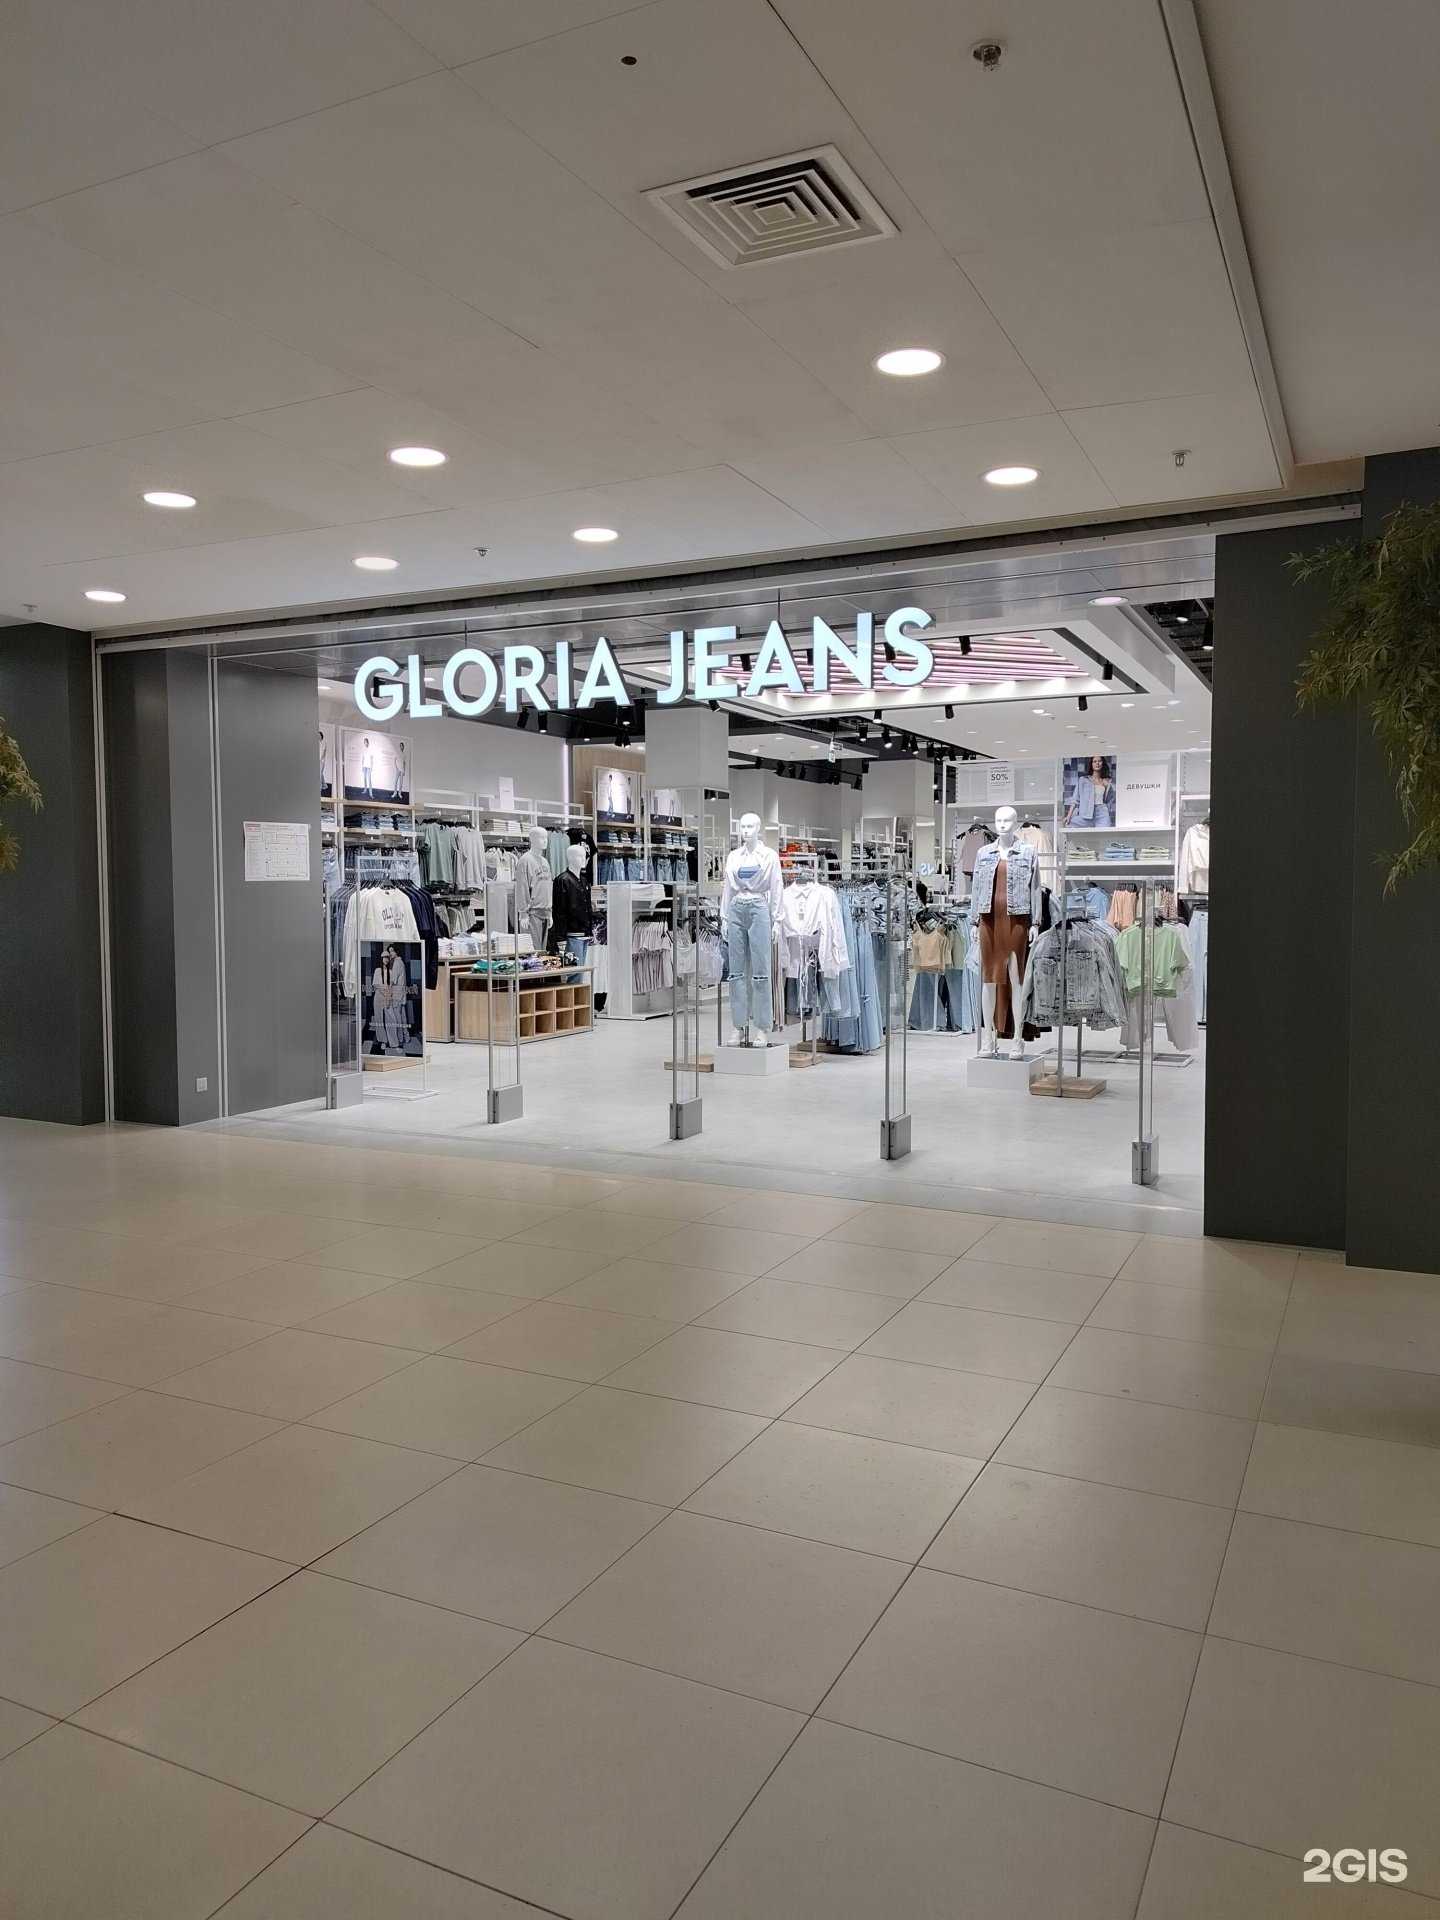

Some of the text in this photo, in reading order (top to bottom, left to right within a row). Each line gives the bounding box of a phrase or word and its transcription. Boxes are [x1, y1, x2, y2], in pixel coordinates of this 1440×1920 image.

[353, 606, 935, 722] GLORIA JEANS
[991, 773, 1009, 781] 50%
